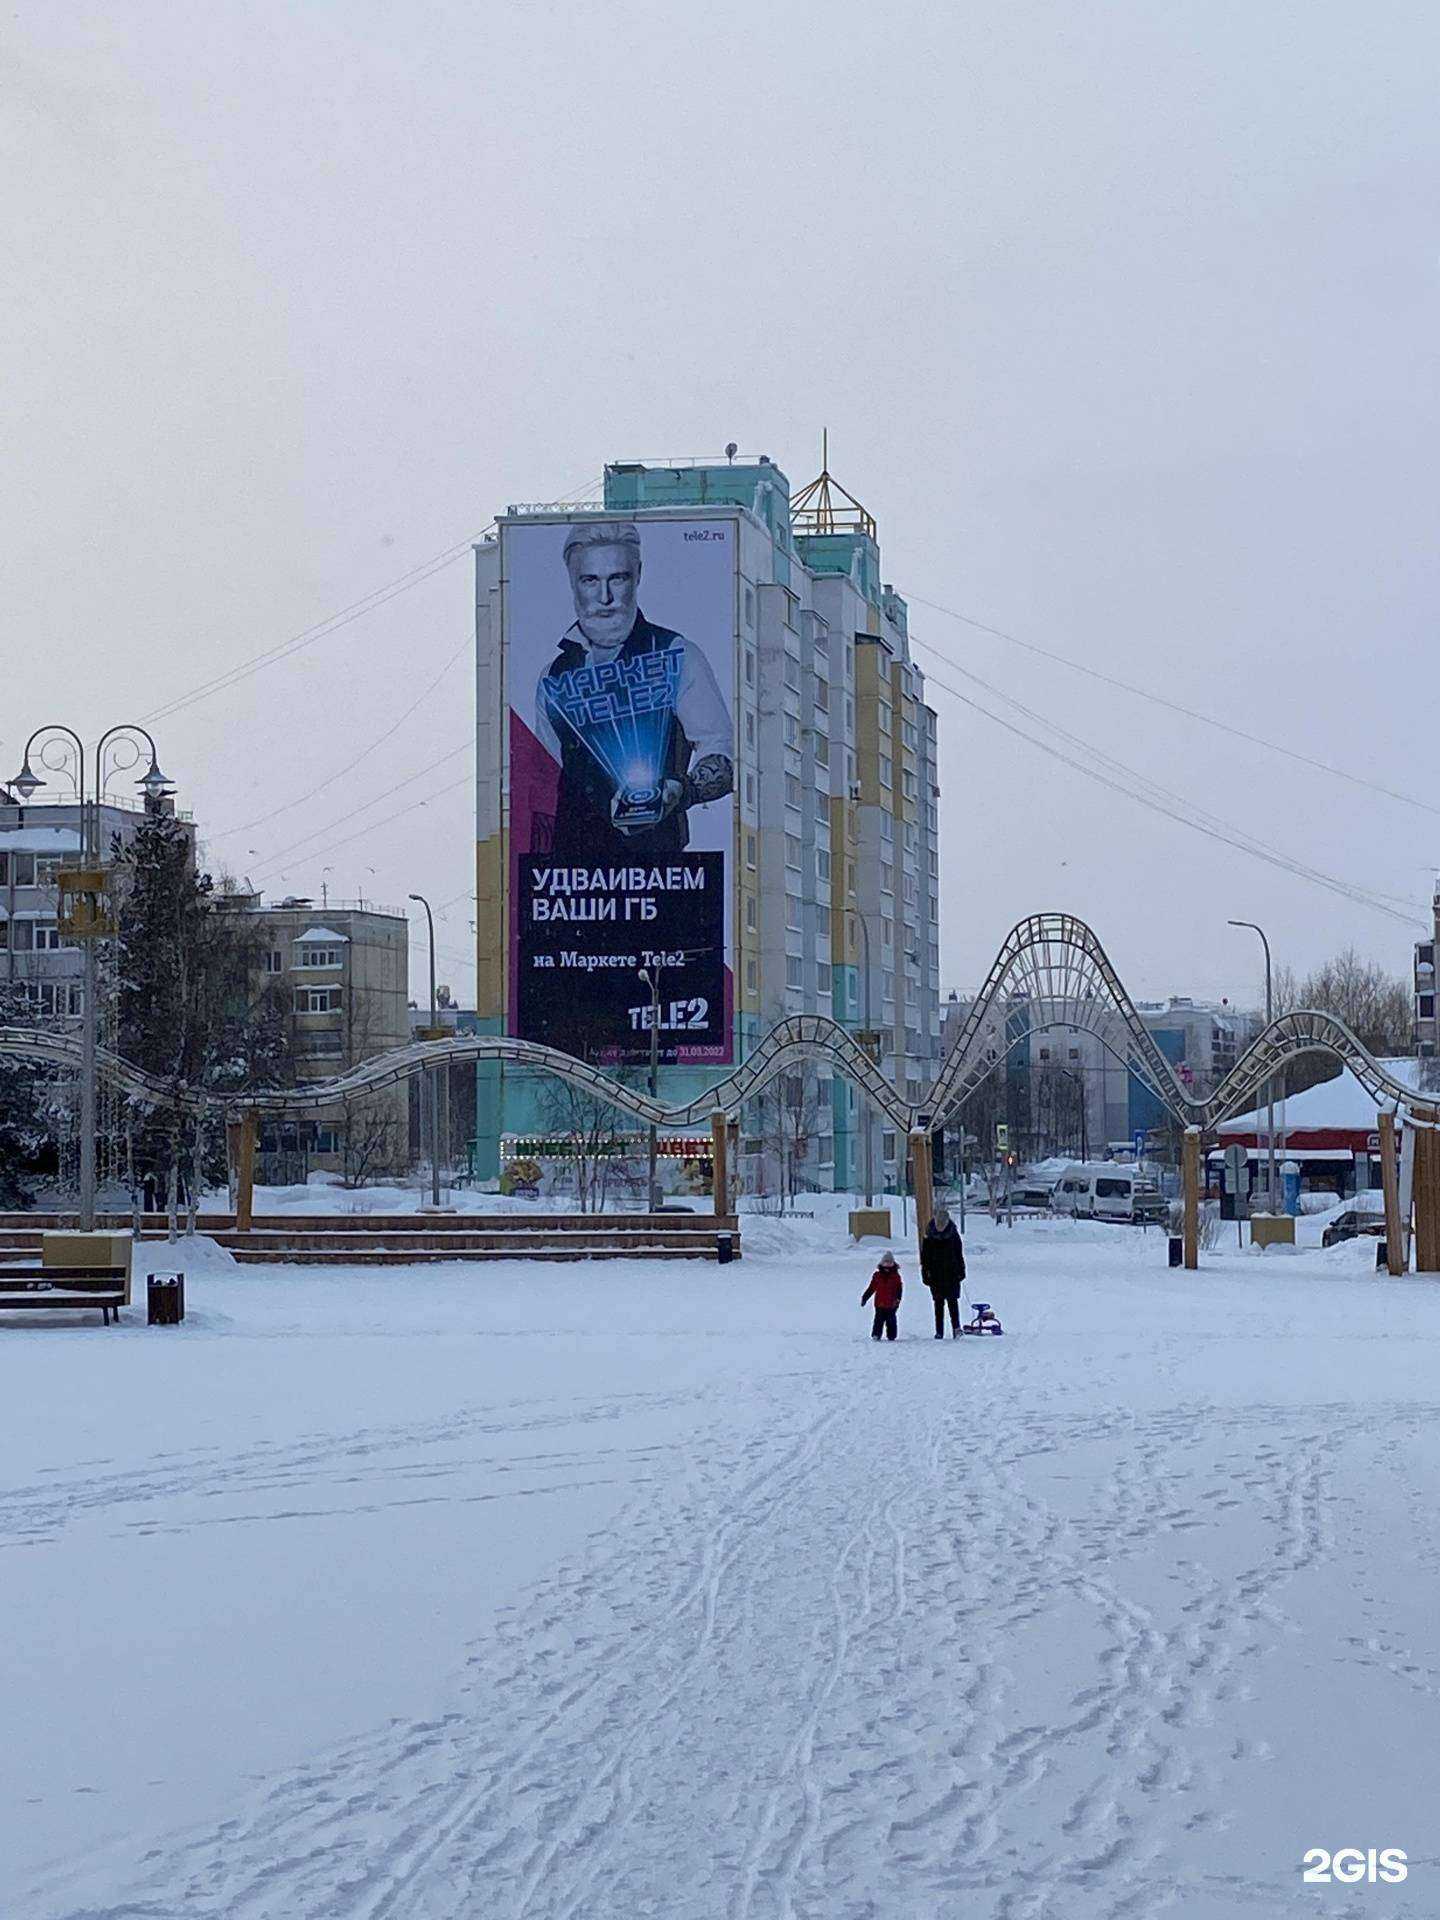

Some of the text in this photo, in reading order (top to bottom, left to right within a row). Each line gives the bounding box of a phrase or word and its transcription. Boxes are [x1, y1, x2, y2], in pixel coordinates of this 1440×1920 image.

[684, 530, 725, 541] tele2.ru
[542, 648, 685, 698] МАРКЕТ
[565, 682, 674, 727] TELE2
[532, 867, 705, 895] УДВАИВАЕМ
[532, 898, 658, 921] ВАШИ ГБ
[533, 951, 685, 972] на Маркете Tele2
[628, 997, 709, 1030] TELE2
